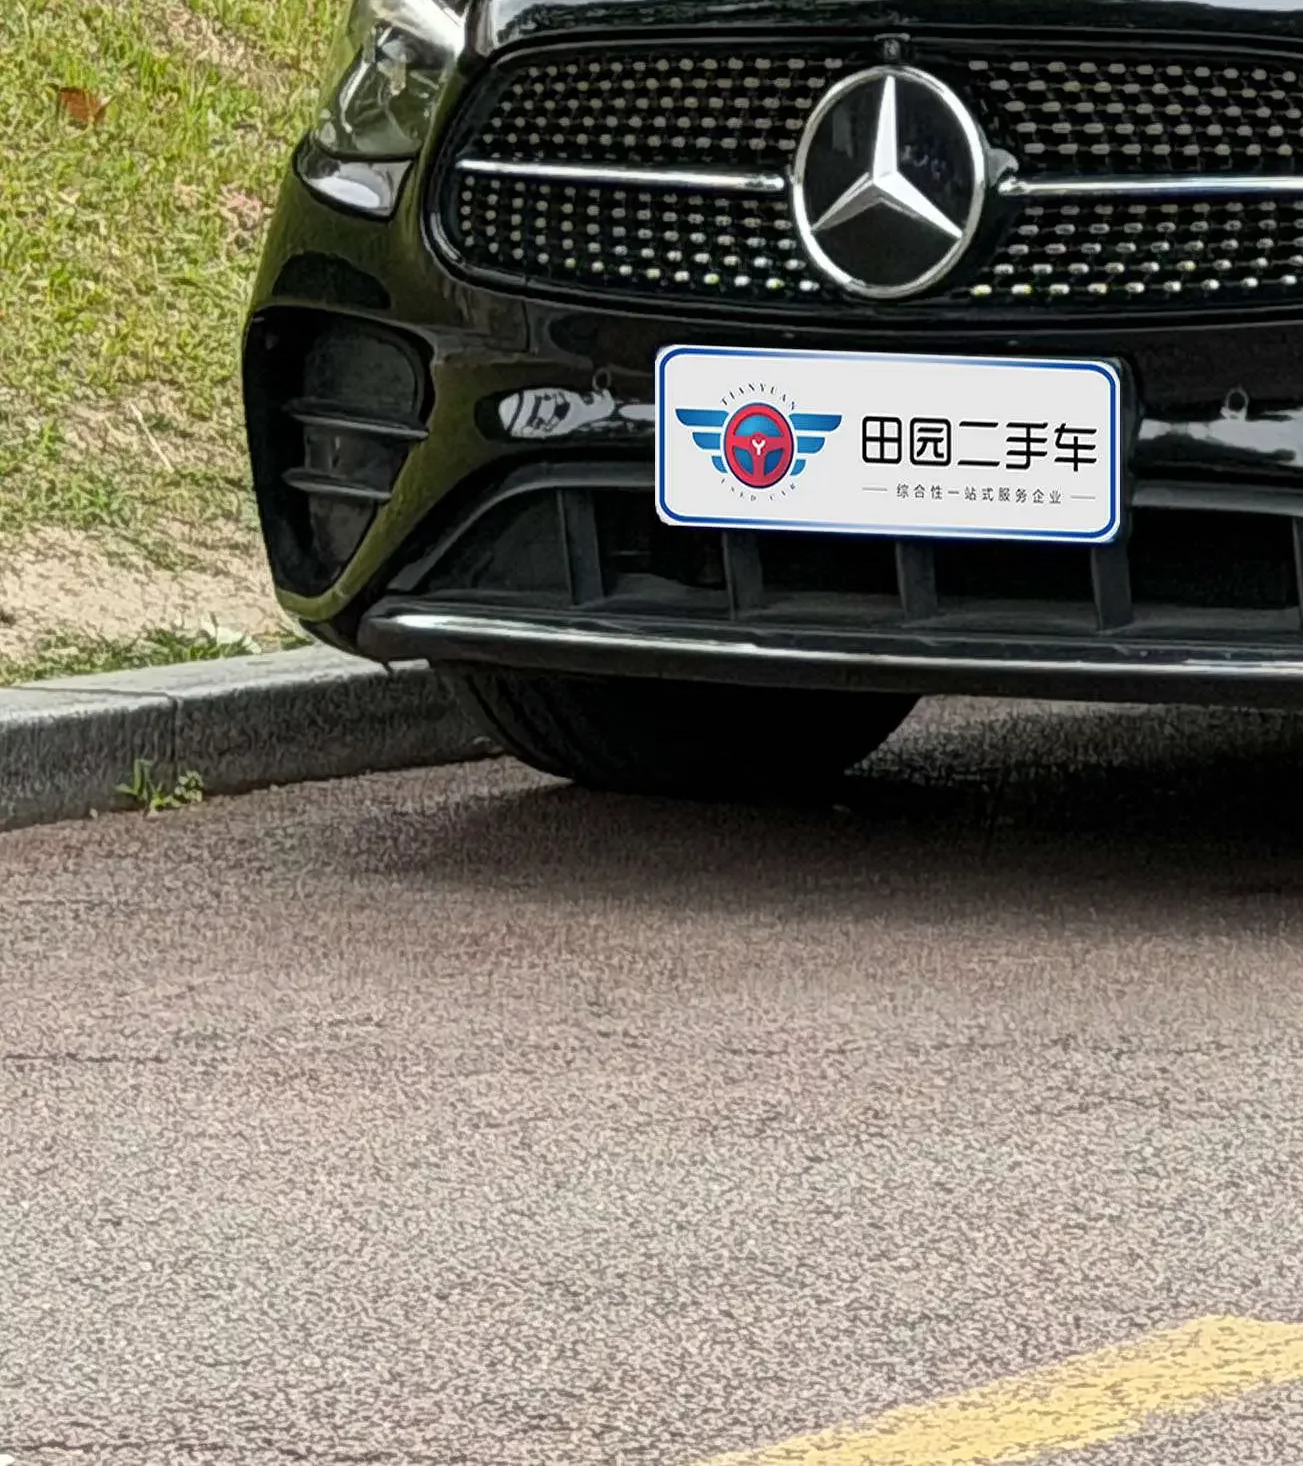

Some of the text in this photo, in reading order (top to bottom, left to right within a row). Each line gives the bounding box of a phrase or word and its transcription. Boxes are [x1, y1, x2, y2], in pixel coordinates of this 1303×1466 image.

[861, 415, 1098, 472] 田园二手车
[896, 483, 1062, 505] 综合性一站式服务企业
